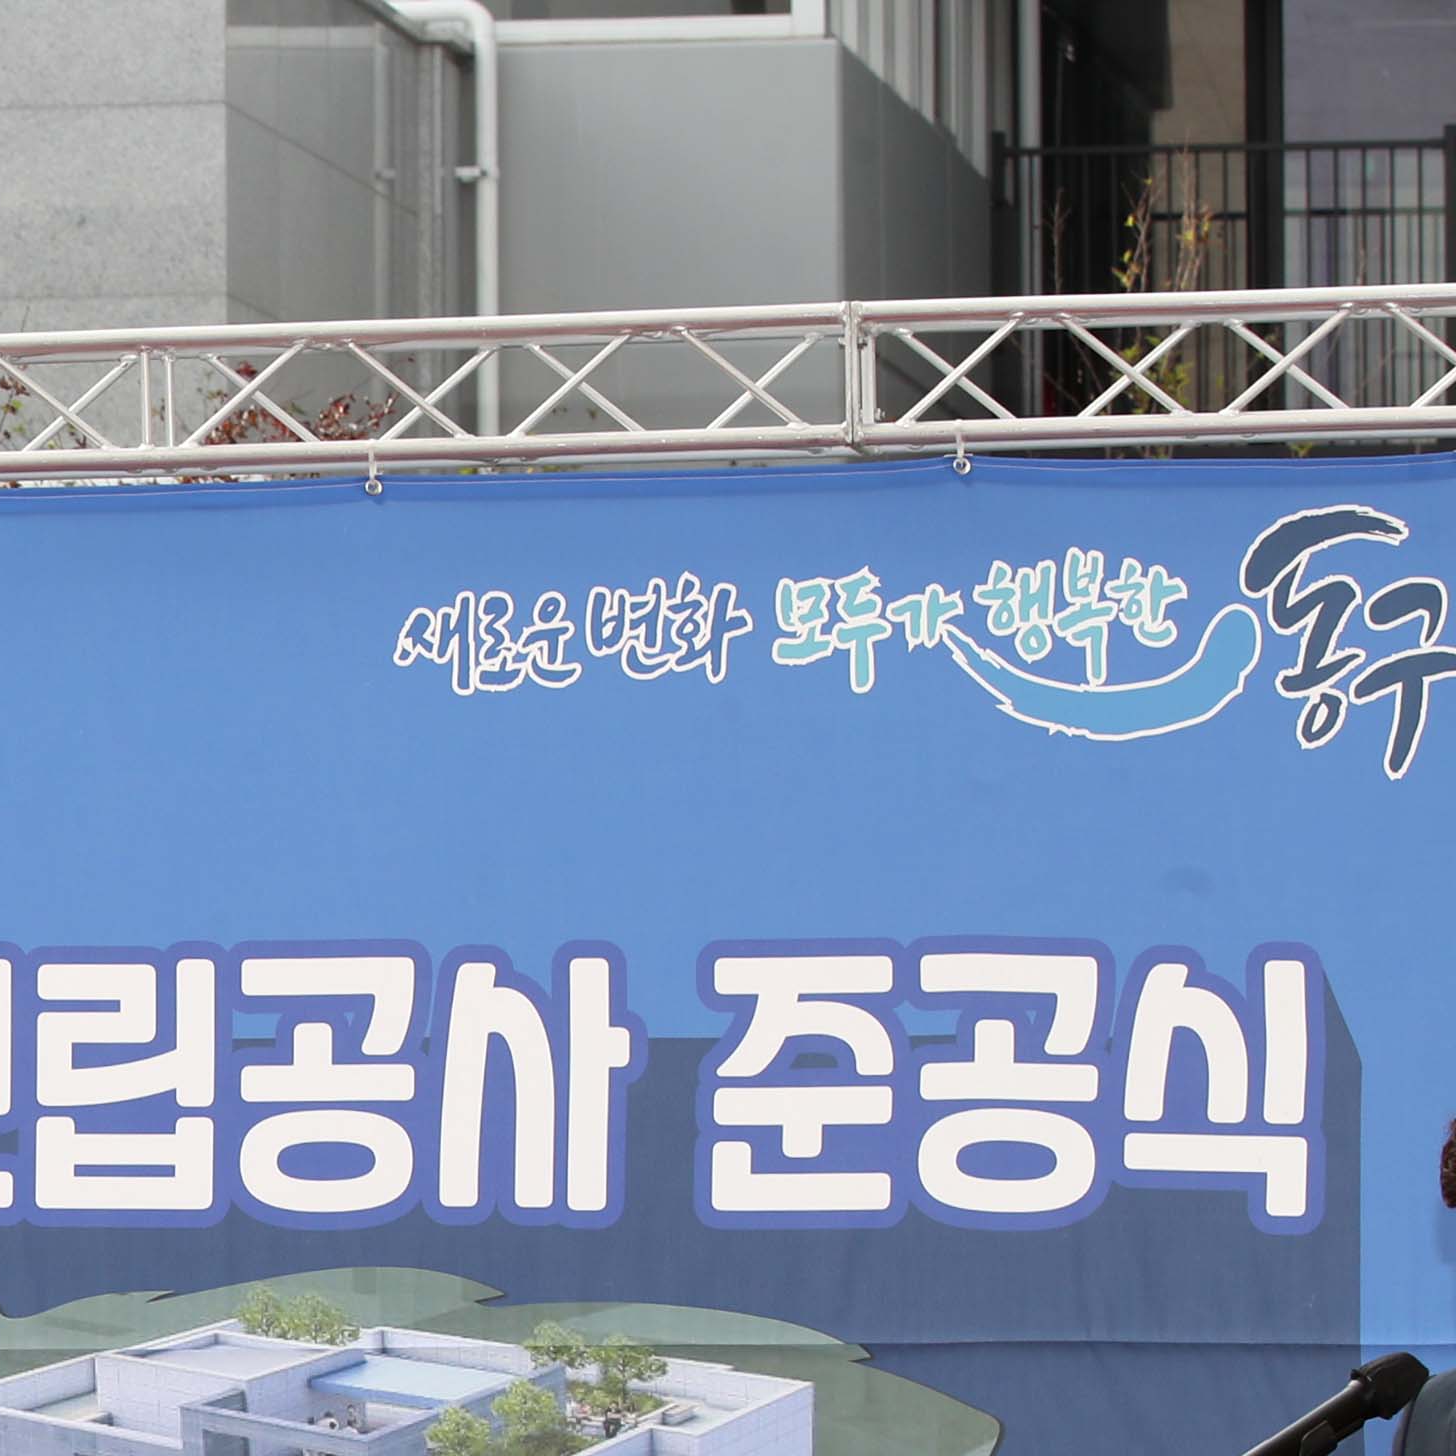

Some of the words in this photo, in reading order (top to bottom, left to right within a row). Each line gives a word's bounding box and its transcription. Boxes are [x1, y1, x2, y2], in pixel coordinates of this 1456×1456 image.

[393, 591, 582, 695] 새로운
[584, 570, 753, 684] 변화
[772, 565, 963, 694] 모두가
[973, 546, 1188, 687] 행복한
[1239, 504, 1456, 781] 동구
[711, 952, 1308, 1217] 준공식
